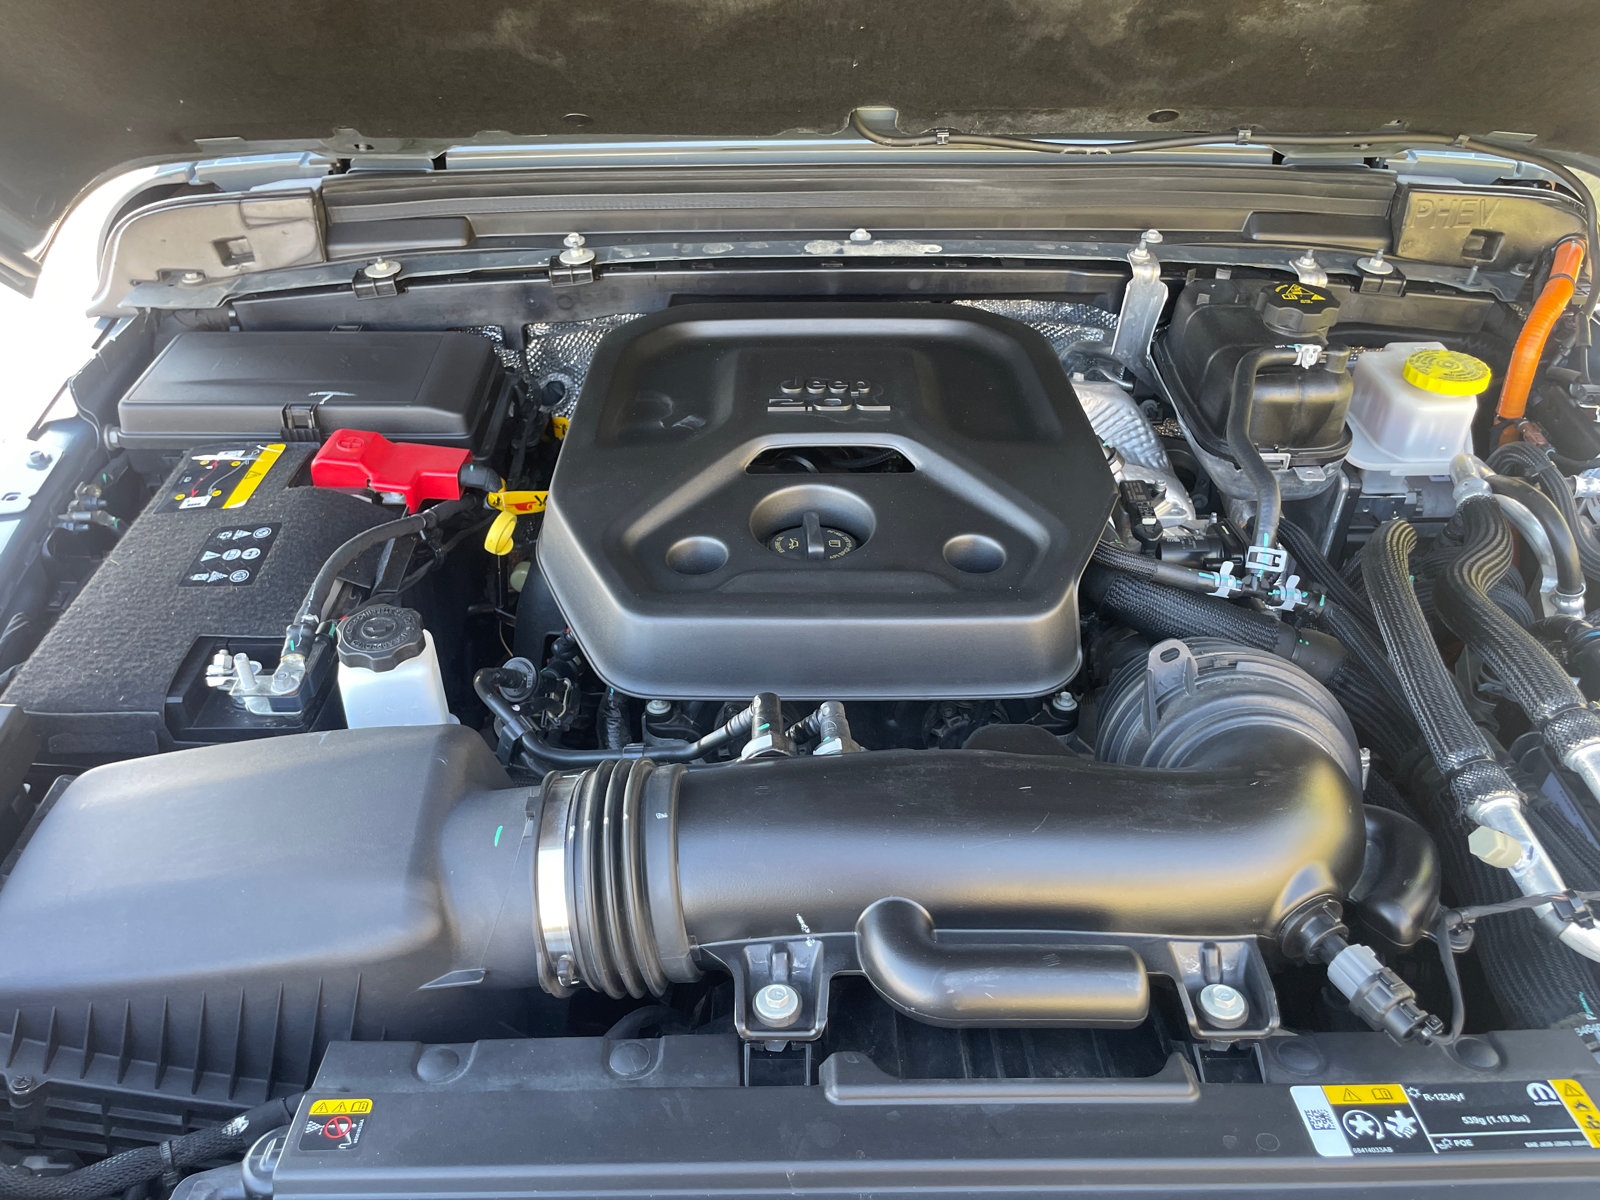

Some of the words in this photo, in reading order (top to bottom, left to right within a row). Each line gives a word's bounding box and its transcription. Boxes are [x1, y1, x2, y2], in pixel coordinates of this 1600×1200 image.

[1409, 197, 1501, 230] PHEV
[779, 377, 871, 396] Jeep
[1422, 1092, 1465, 1102] R-1234yf
[1509, 1114, 1531, 1124] lbs)
[1453, 1138, 1474, 1147] POE
